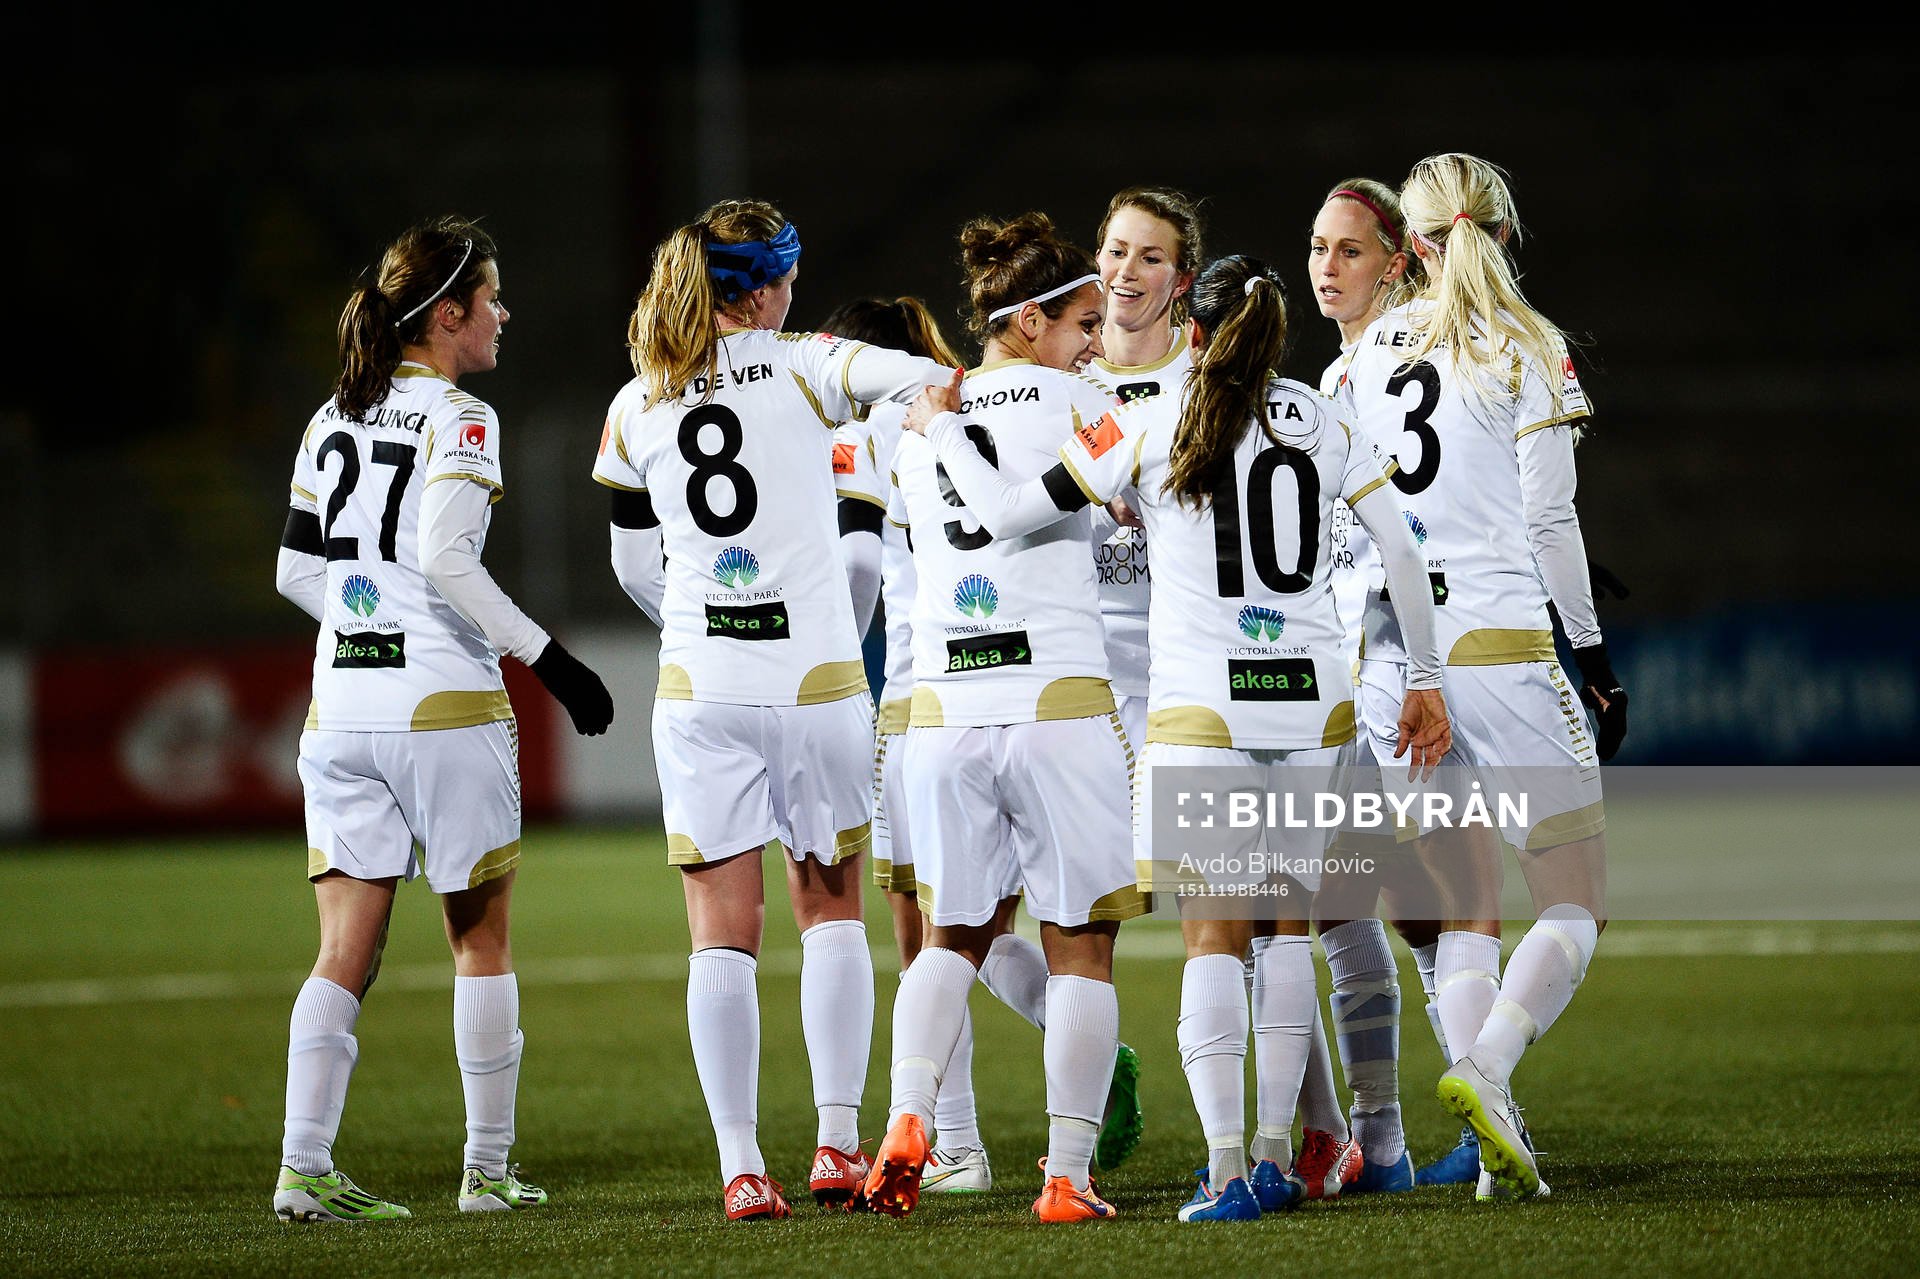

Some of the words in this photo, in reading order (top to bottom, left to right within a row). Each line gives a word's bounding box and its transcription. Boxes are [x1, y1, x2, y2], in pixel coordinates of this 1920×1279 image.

[731, 364, 773, 385] VEN
[1385, 361, 1441, 495] 3
[444, 450, 479, 459] SVENSKA
[678, 404, 758, 538] 8
[316, 431, 417, 563] 27
[1212, 445, 1321, 598] 10
[705, 593, 751, 602] VICTORIA
[754, 589, 780, 600] PARK
[377, 621, 400, 630] PARK
[709, 614, 760, 629] akea
[944, 623, 991, 635] VICTORIA
[336, 640, 378, 658] akea
[1226, 647, 1280, 655] VICTORIA
[950, 649, 1002, 670] akea
[1231, 669, 1289, 689] akea
[810, 1169, 844, 1183] adidas
[730, 1195, 766, 1212] adidas
